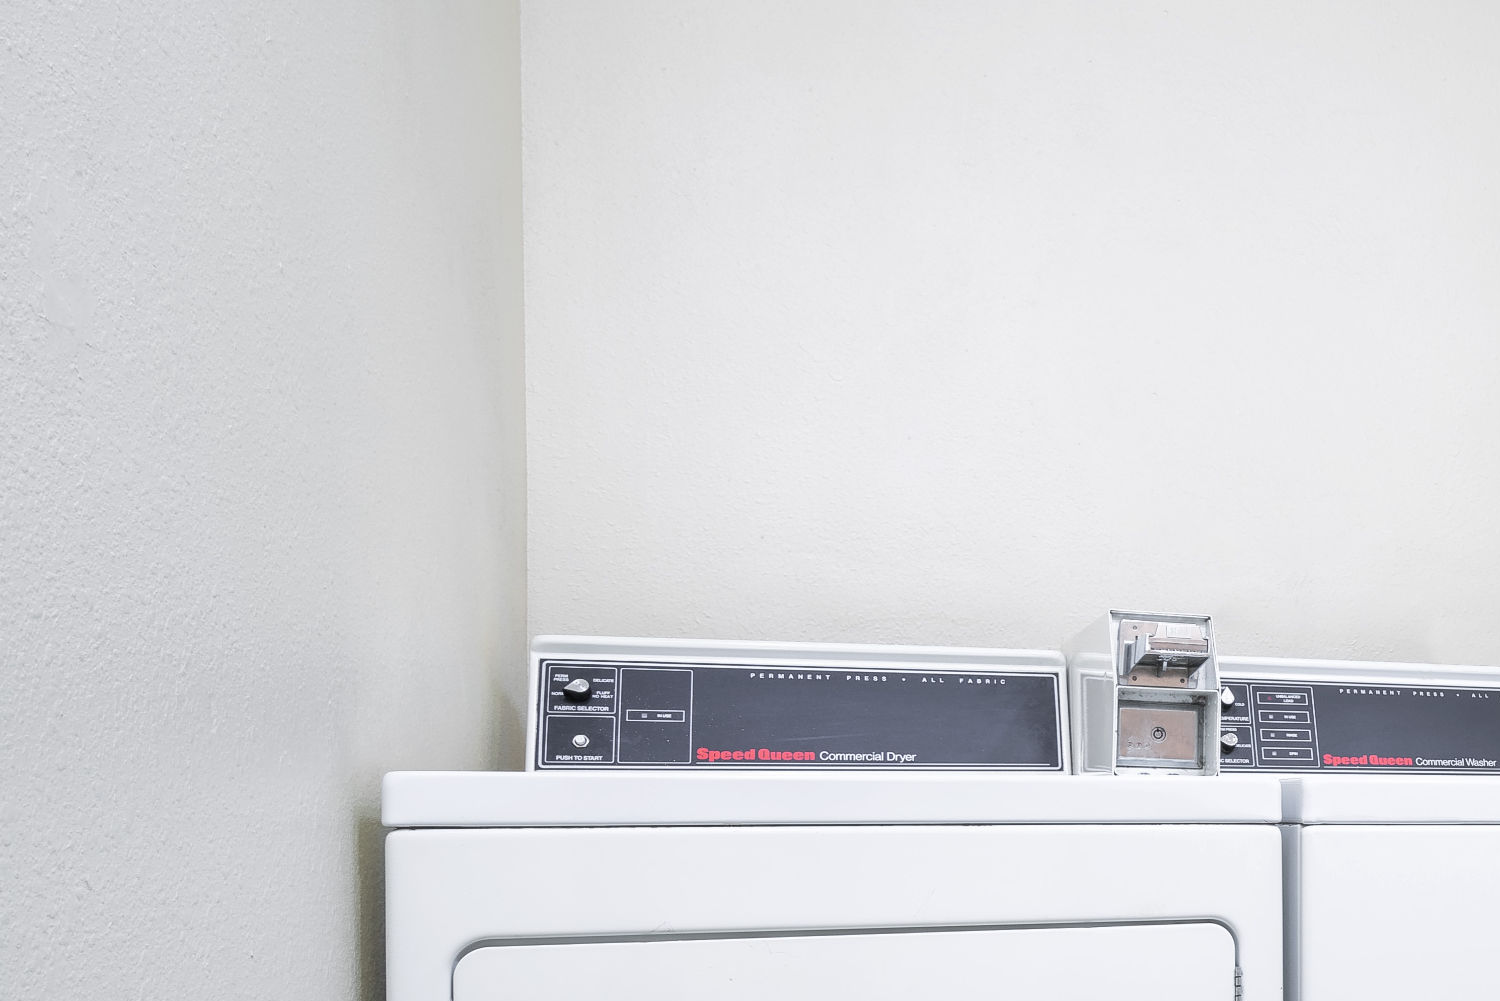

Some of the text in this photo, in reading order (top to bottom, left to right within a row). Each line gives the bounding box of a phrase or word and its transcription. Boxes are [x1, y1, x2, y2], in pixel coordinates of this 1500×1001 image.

[750, 671, 831, 680] PERMANENT
[1340, 688, 1402, 696] PERMANENT
[697, 748, 917, 762] Speed Queen Commercial Dryer
[1323, 754, 1497, 767] Speed Queen Commercial Washer
